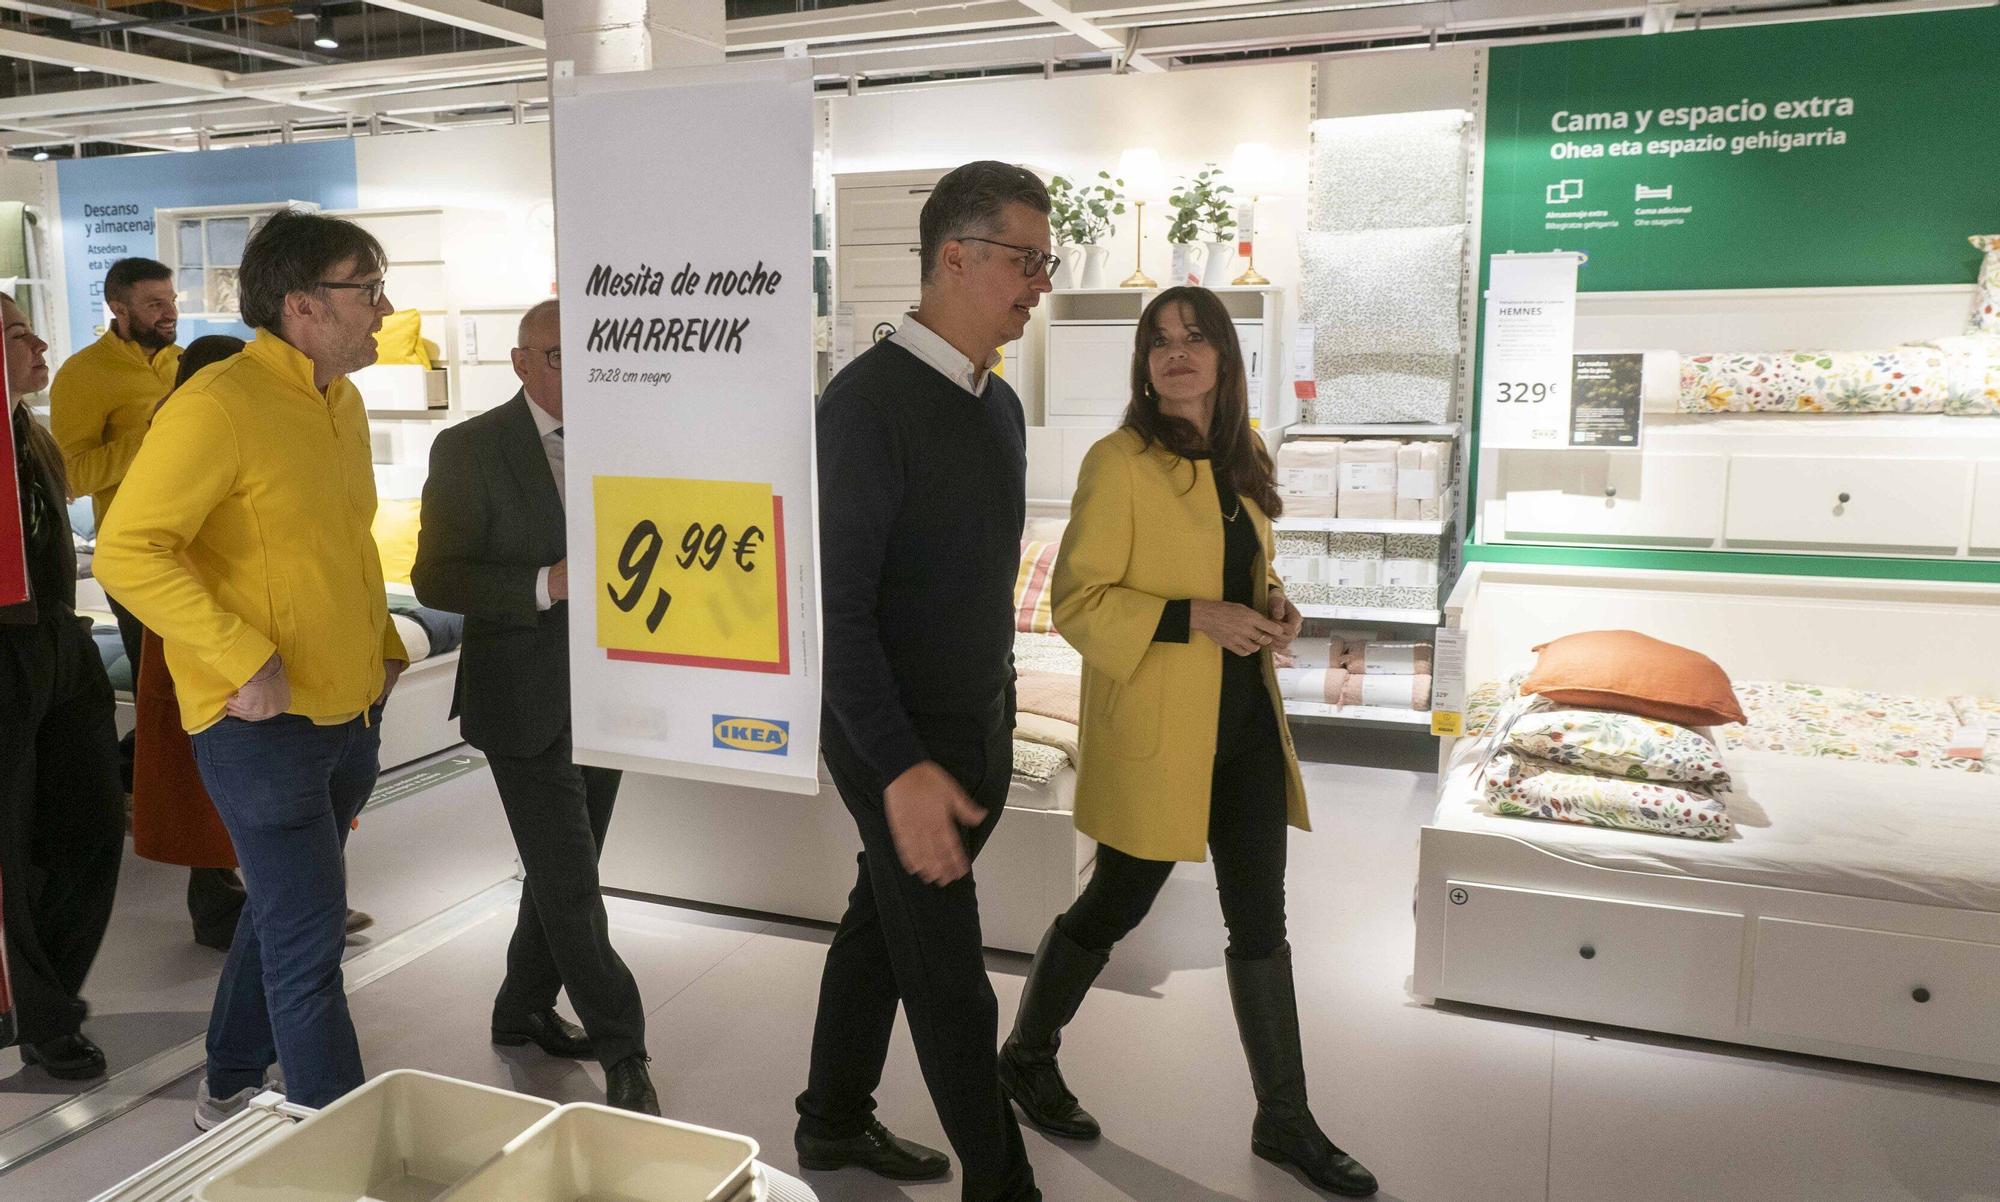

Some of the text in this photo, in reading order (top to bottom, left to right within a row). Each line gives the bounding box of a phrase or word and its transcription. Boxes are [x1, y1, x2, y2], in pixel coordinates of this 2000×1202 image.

[1551, 96, 1854, 134] Cama y espacio extra
[1550, 127, 1847, 160] Ohea eta espazio gehigarria
[84, 203, 139, 217] Descanso
[85, 217, 155, 238] y almacenaj
[88, 244, 128, 255] Atsedena
[89, 260, 103, 270] eta
[585, 260, 782, 297] Mesita de noche
[1499, 307, 1543, 316] HEMNES
[586, 316, 751, 354] KNARREVIK
[588, 368, 672, 387] 37x28 cm negro
[732, 525, 765, 573] €
[720, 724, 784, 745] IKEA
